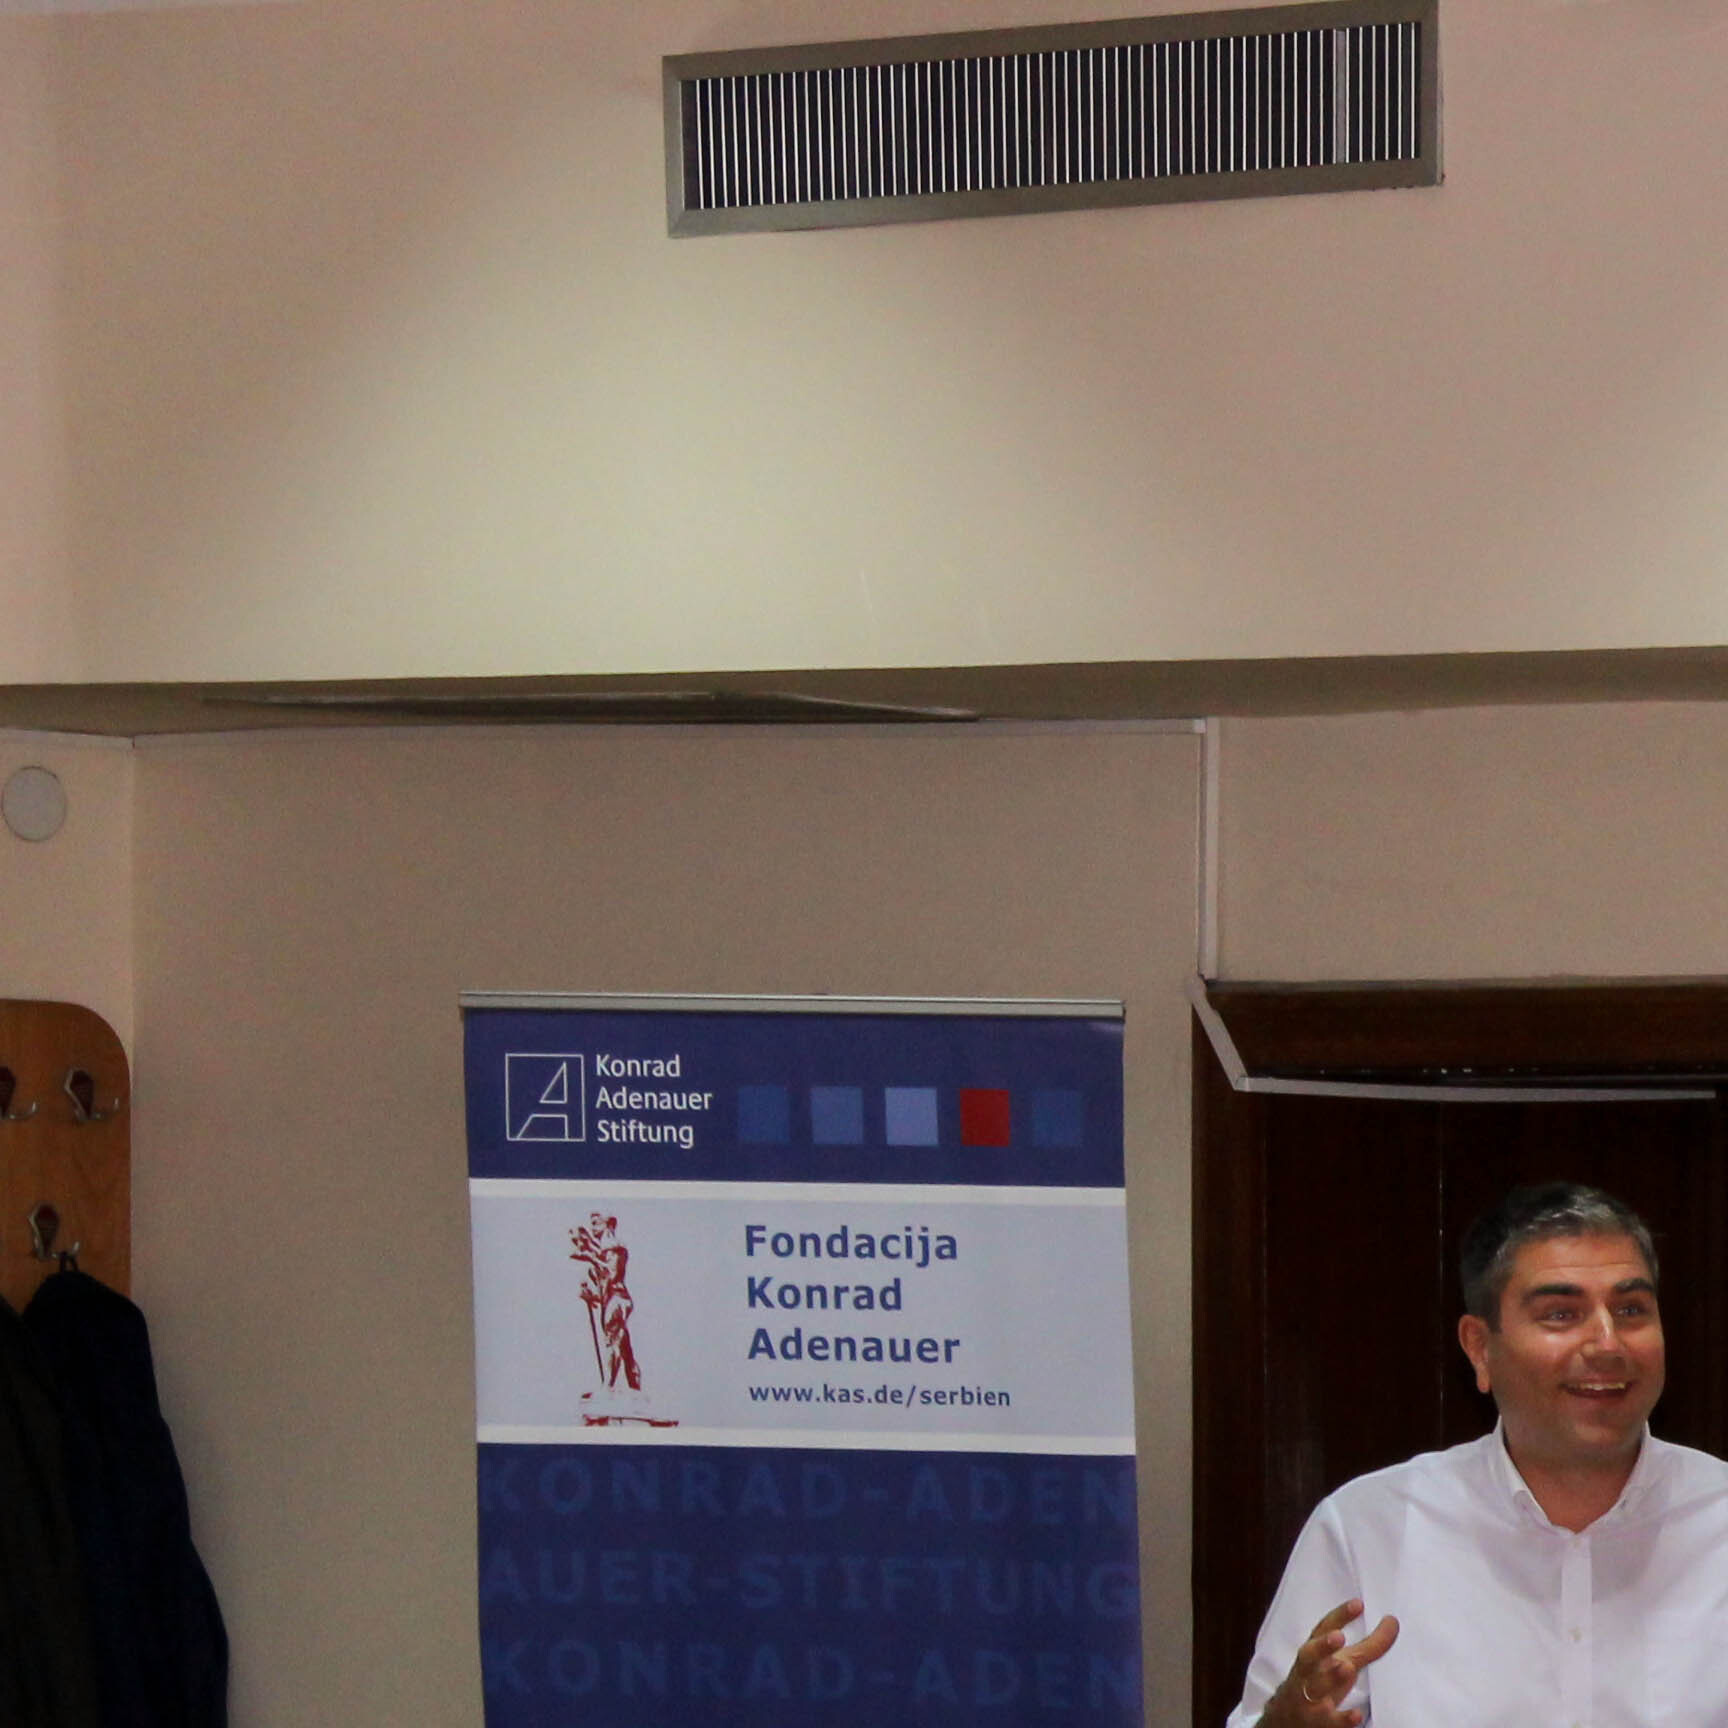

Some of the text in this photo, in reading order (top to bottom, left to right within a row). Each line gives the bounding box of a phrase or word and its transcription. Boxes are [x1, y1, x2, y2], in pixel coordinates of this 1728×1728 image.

[596, 1054, 681, 1077] Konrad
[596, 1087, 713, 1111] Adenauer
[597, 1119, 694, 1148] Stiftung
[744, 1225, 958, 1268] Fondacija
[747, 1277, 903, 1311] Konrad
[748, 1328, 961, 1364] Adenauer
[749, 1383, 1011, 1408] www.kas.de/serbien
